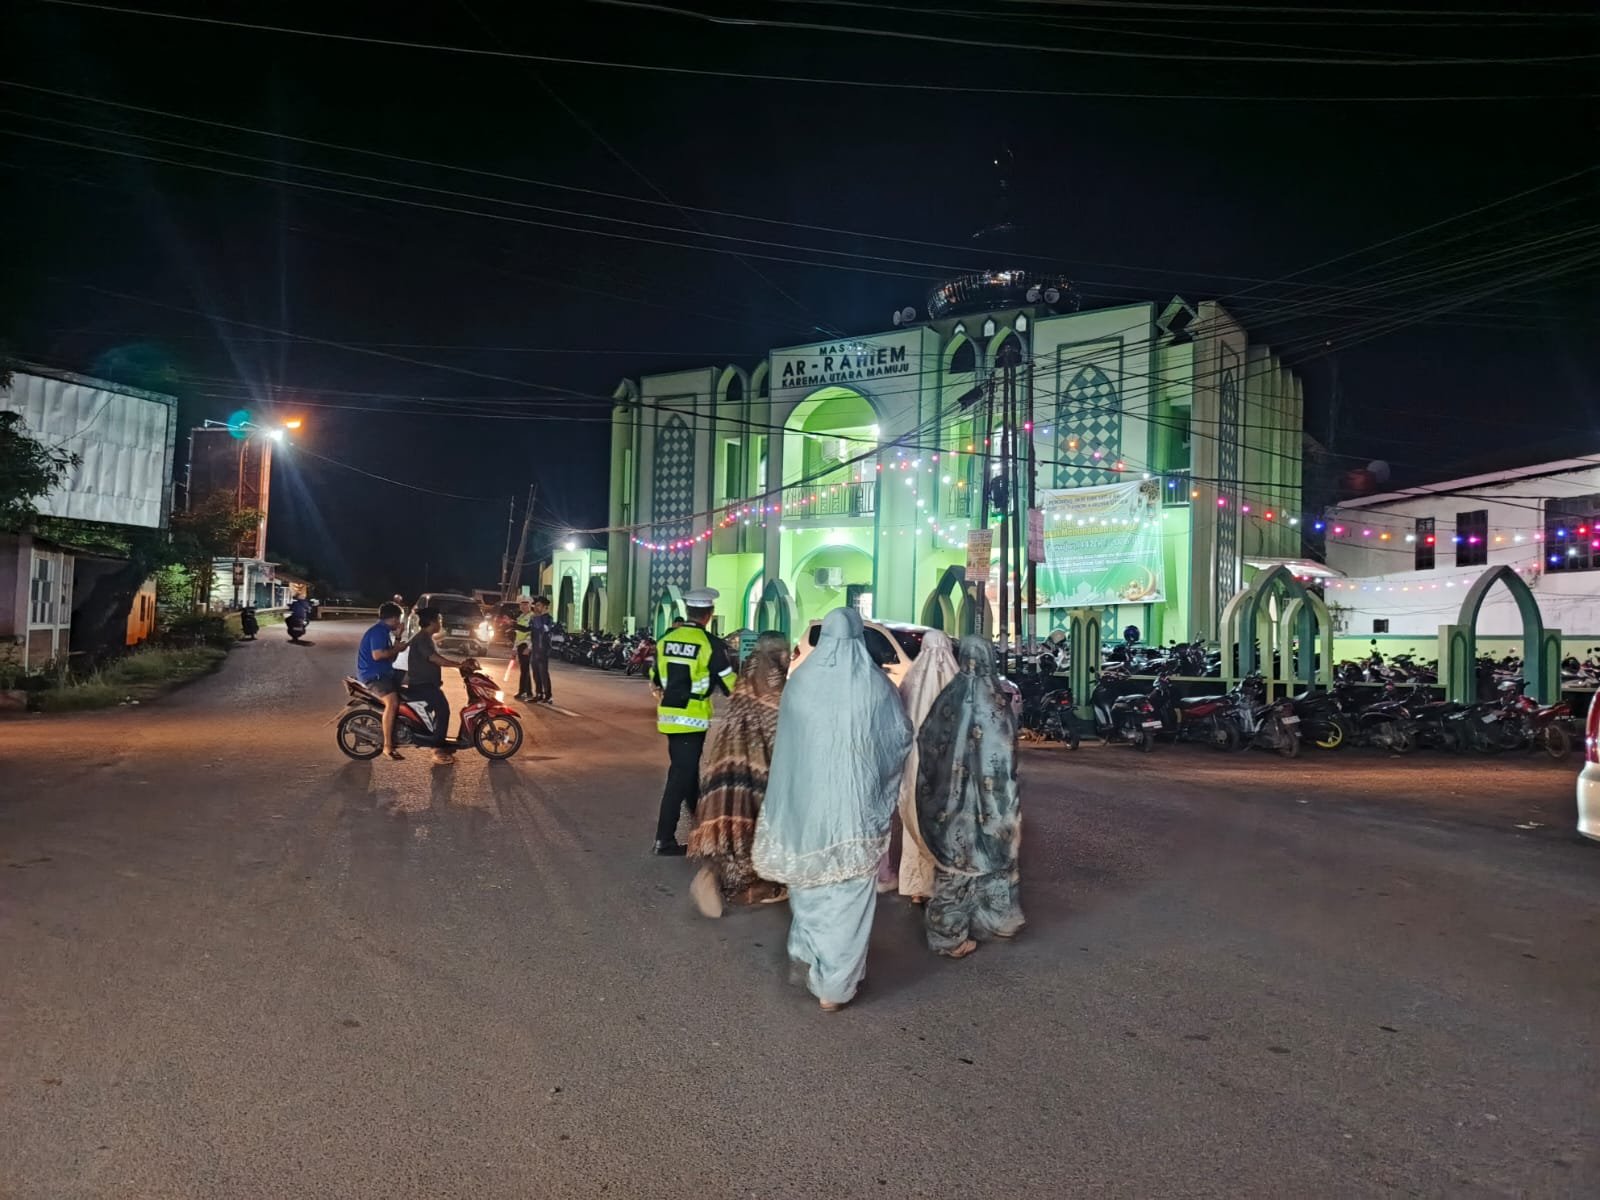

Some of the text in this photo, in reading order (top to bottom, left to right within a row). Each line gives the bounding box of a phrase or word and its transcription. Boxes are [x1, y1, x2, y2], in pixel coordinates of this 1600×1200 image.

[782, 362, 909, 388] KAREMA UTARA MAMUJU
[665, 642, 696, 657] POLISI
